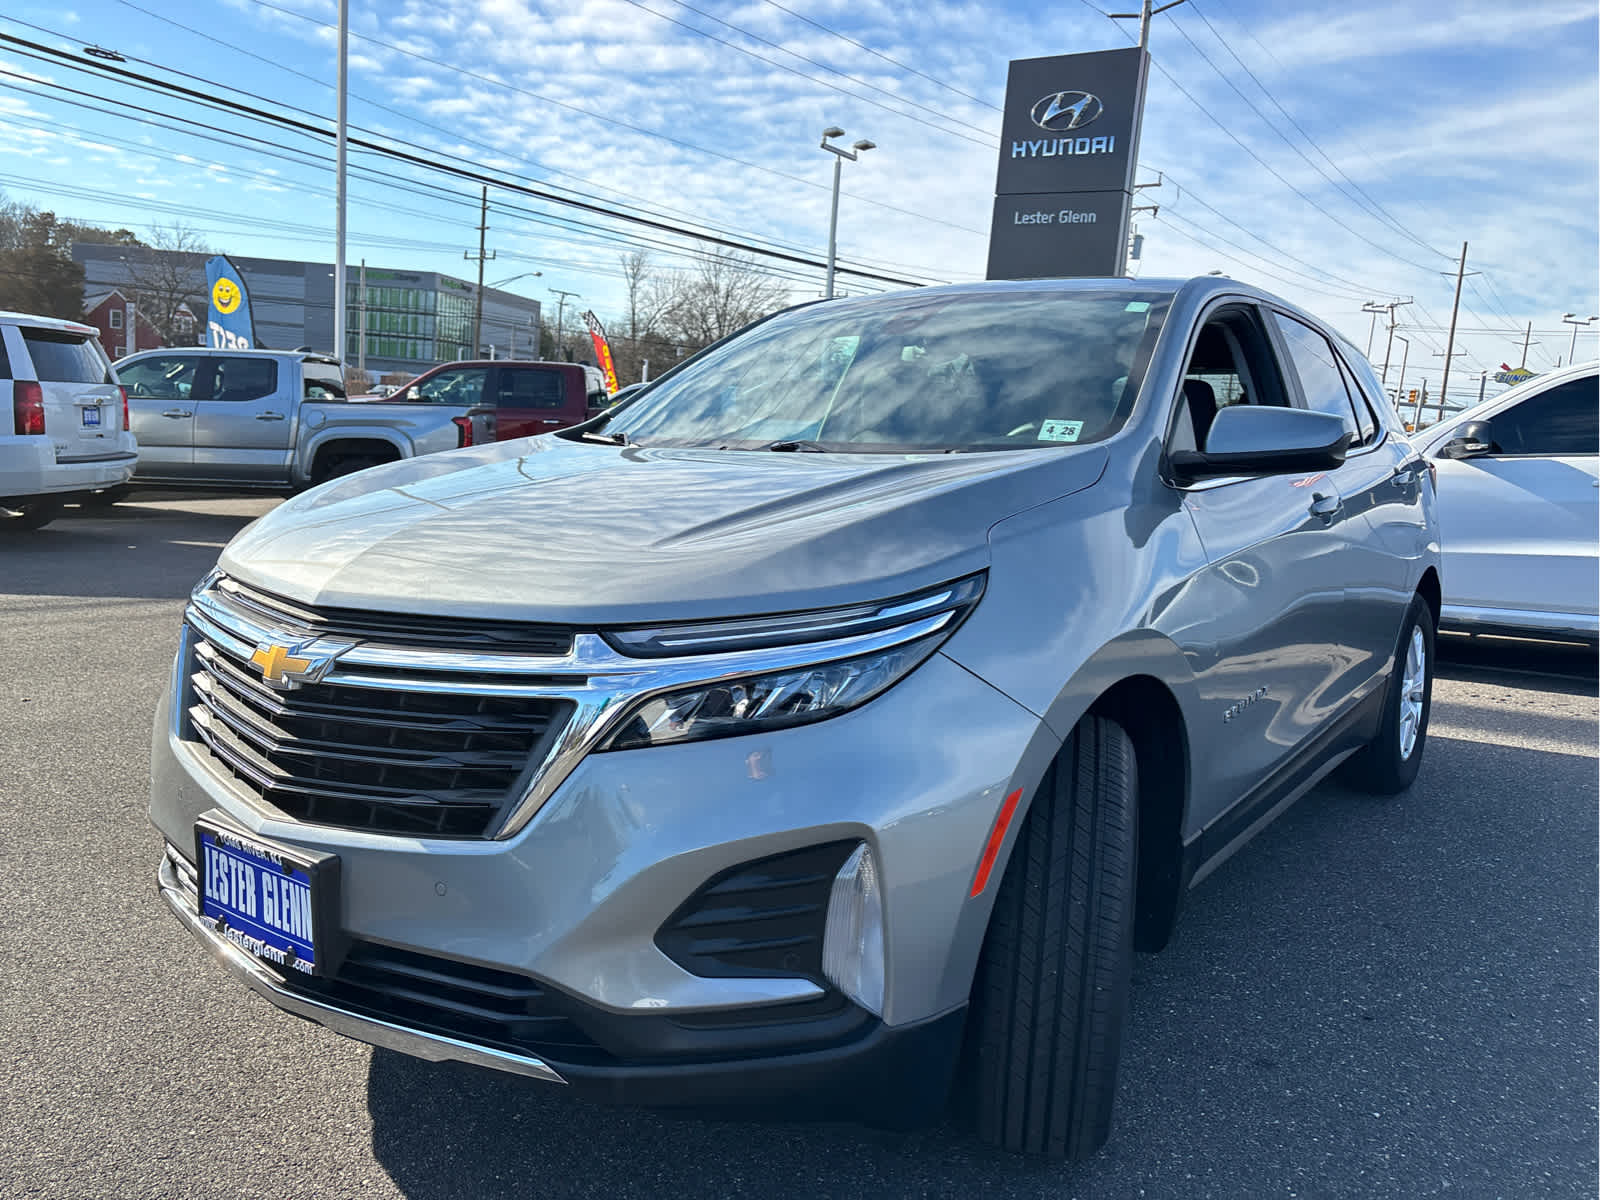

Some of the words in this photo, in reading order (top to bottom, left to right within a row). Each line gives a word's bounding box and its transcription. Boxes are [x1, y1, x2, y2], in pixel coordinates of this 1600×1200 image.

[1012, 135, 1115, 158] HYUNDAI
[1014, 210, 1055, 225] Lester
[1058, 209, 1097, 224] Glenn
[1498, 373, 1531, 383] SUNO
[1046, 425, 1056, 434] 4
[1060, 426, 1076, 436] 28
[203, 846, 257, 918] LESTER
[261, 873, 313, 942] GLENN
